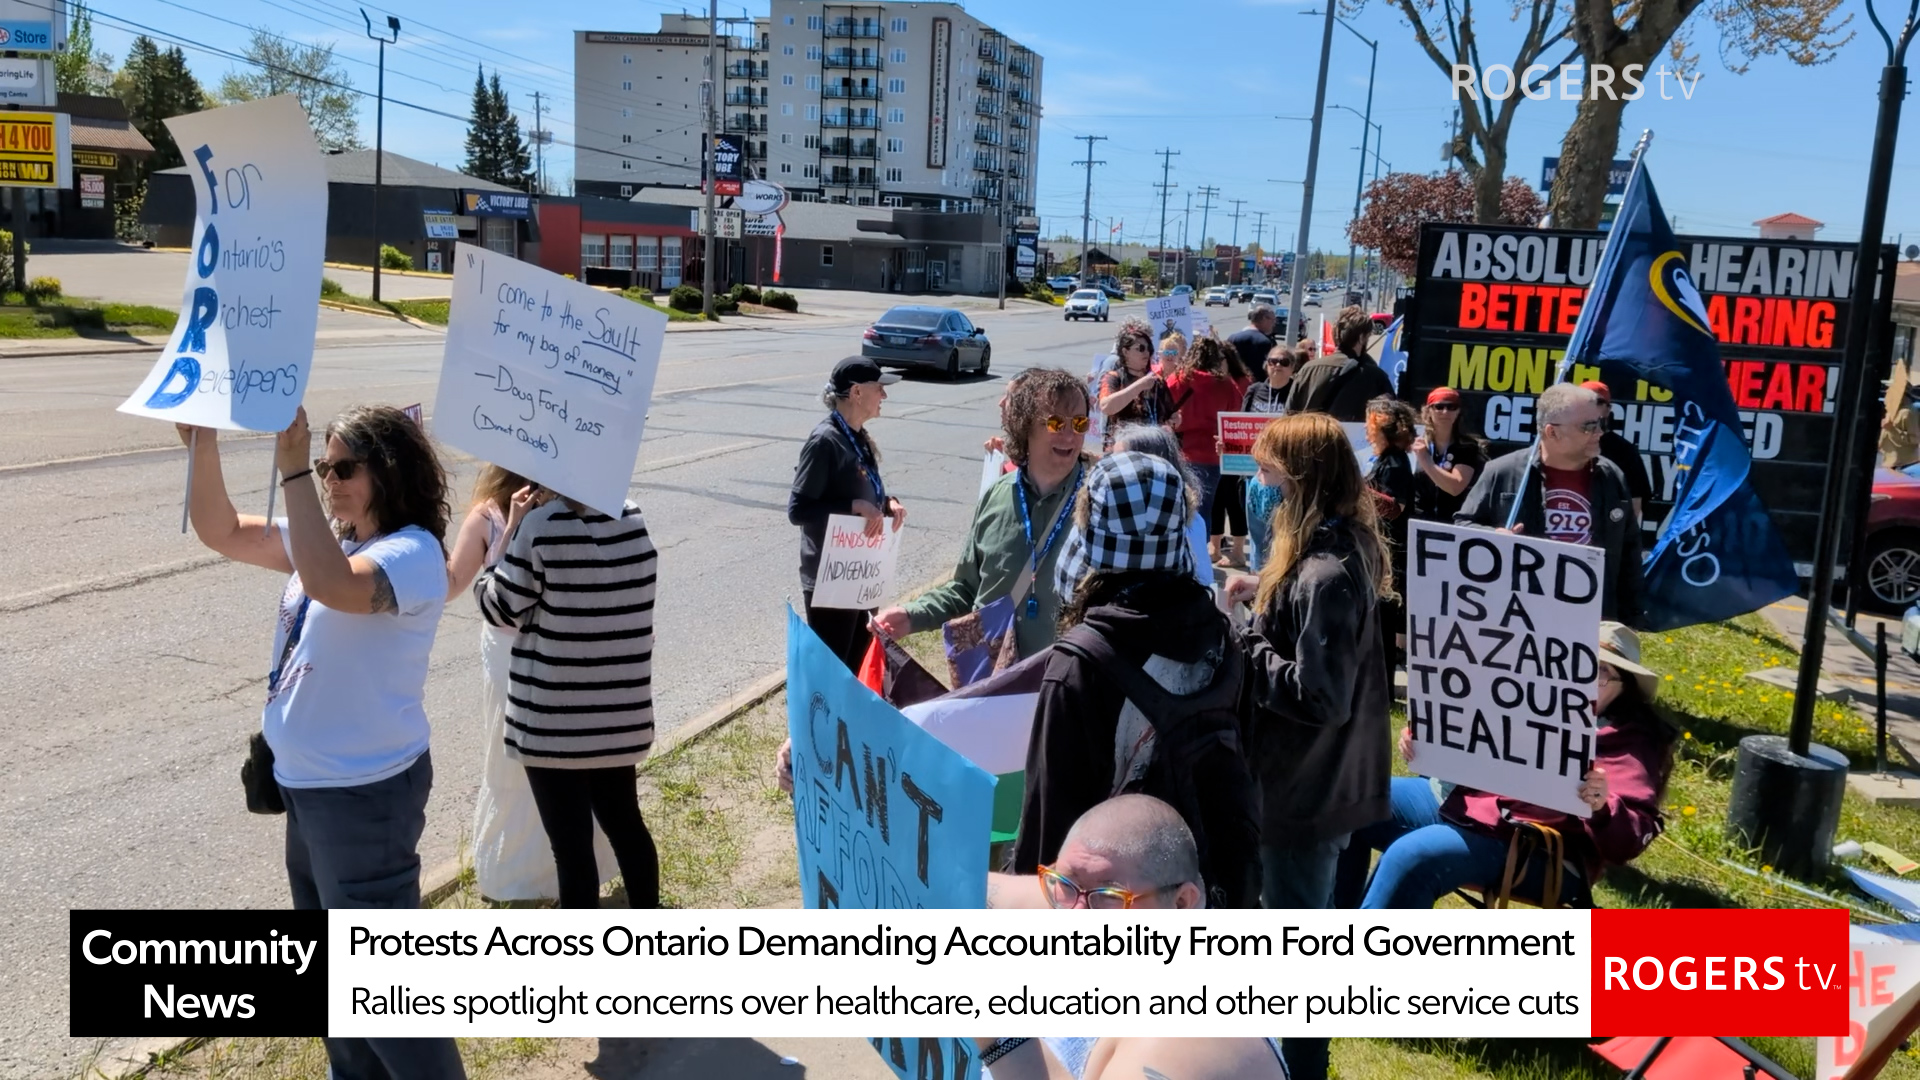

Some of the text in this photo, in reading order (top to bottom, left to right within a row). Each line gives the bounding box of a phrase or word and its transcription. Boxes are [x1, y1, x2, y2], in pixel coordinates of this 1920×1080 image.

[14, 30, 47, 44] Store
[10, 126, 19, 149] 4
[23, 125, 52, 151] YOU
[714, 163, 733, 173] UBE
[490, 195, 529, 209] VICTORY LUBE
[755, 193, 784, 201] WORKS
[427, 241, 438, 250] 142
[1431, 232, 1607, 286] ABSOLU
[1160, 299, 1171, 310] LET
[1458, 283, 1836, 349] BETTE ARING
[498, 283, 535, 312] come
[541, 289, 553, 322] to
[560, 301, 583, 332] the
[588, 308, 641, 356] Sault
[494, 309, 511, 336] for
[517, 331, 535, 355] my
[540, 335, 560, 369] bag
[564, 346, 581, 365] of
[539, 389, 569, 424] Ford
[575, 417, 604, 437] 2025
[1223, 420, 1266, 430] Restore ou
[1484, 395, 1535, 443] GE
[1223, 430, 1260, 440] health ca
[1225, 443, 1243, 453] Stop
[1545, 512, 1590, 531] 919
[831, 525, 886, 550] HANDS OFF
[822, 553, 882, 584] INDIGENOUS
[1416, 529, 1598, 604] FORD
[856, 580, 885, 604] LANDS
[1440, 581, 1535, 632] IS A
[1410, 614, 1599, 684] HAZARD
[1411, 663, 1593, 728] TO OUR
[1410, 697, 1593, 781] HEALTH
[810, 692, 943, 888] CAN'T
